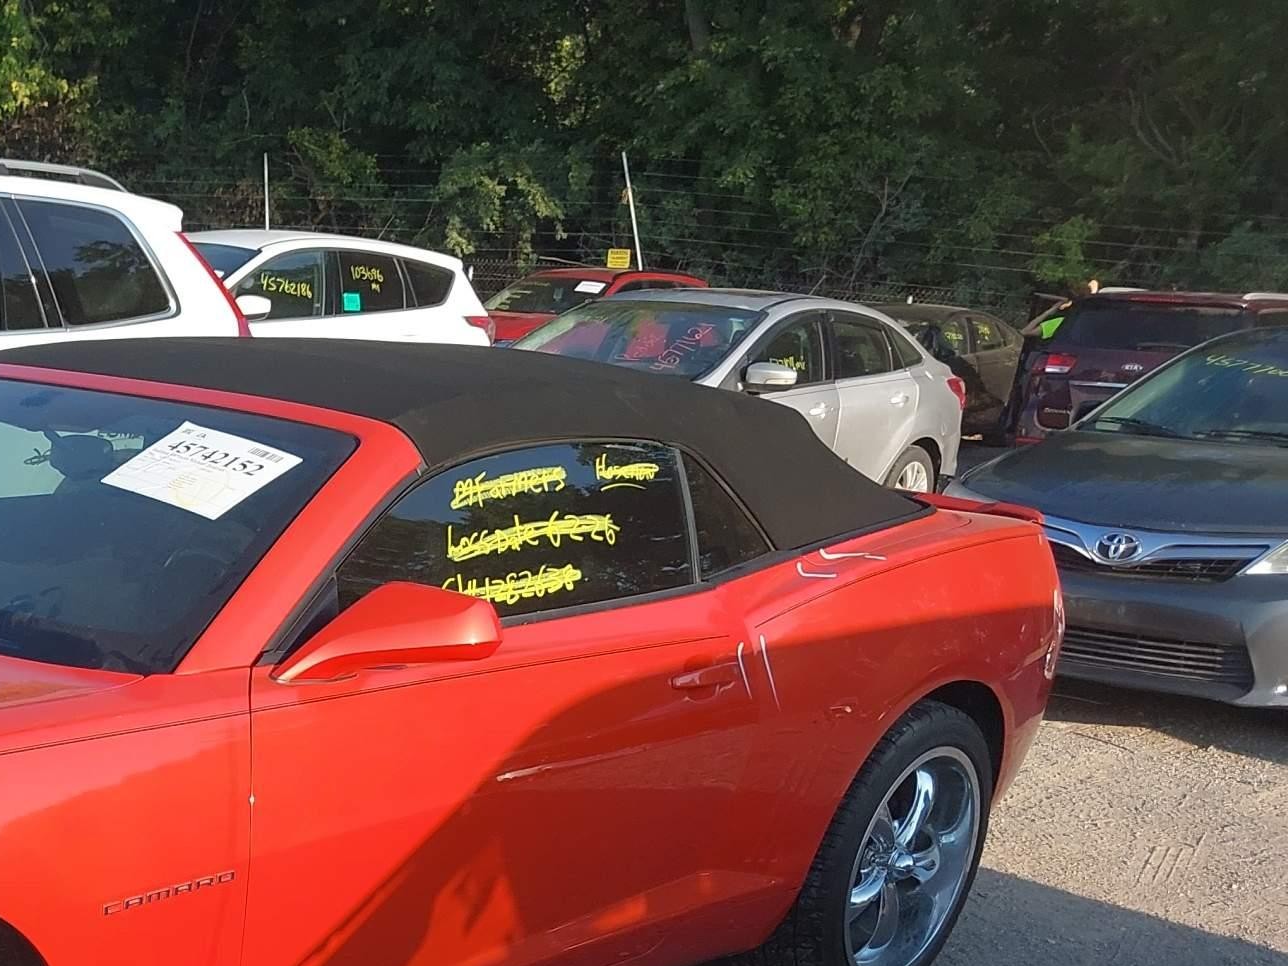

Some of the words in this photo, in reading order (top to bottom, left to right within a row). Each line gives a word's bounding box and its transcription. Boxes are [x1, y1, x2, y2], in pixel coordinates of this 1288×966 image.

[260, 273, 312, 299] 45762186
[167, 440, 265, 477] 45742152
[103, 869, 236, 916] CAMARO
